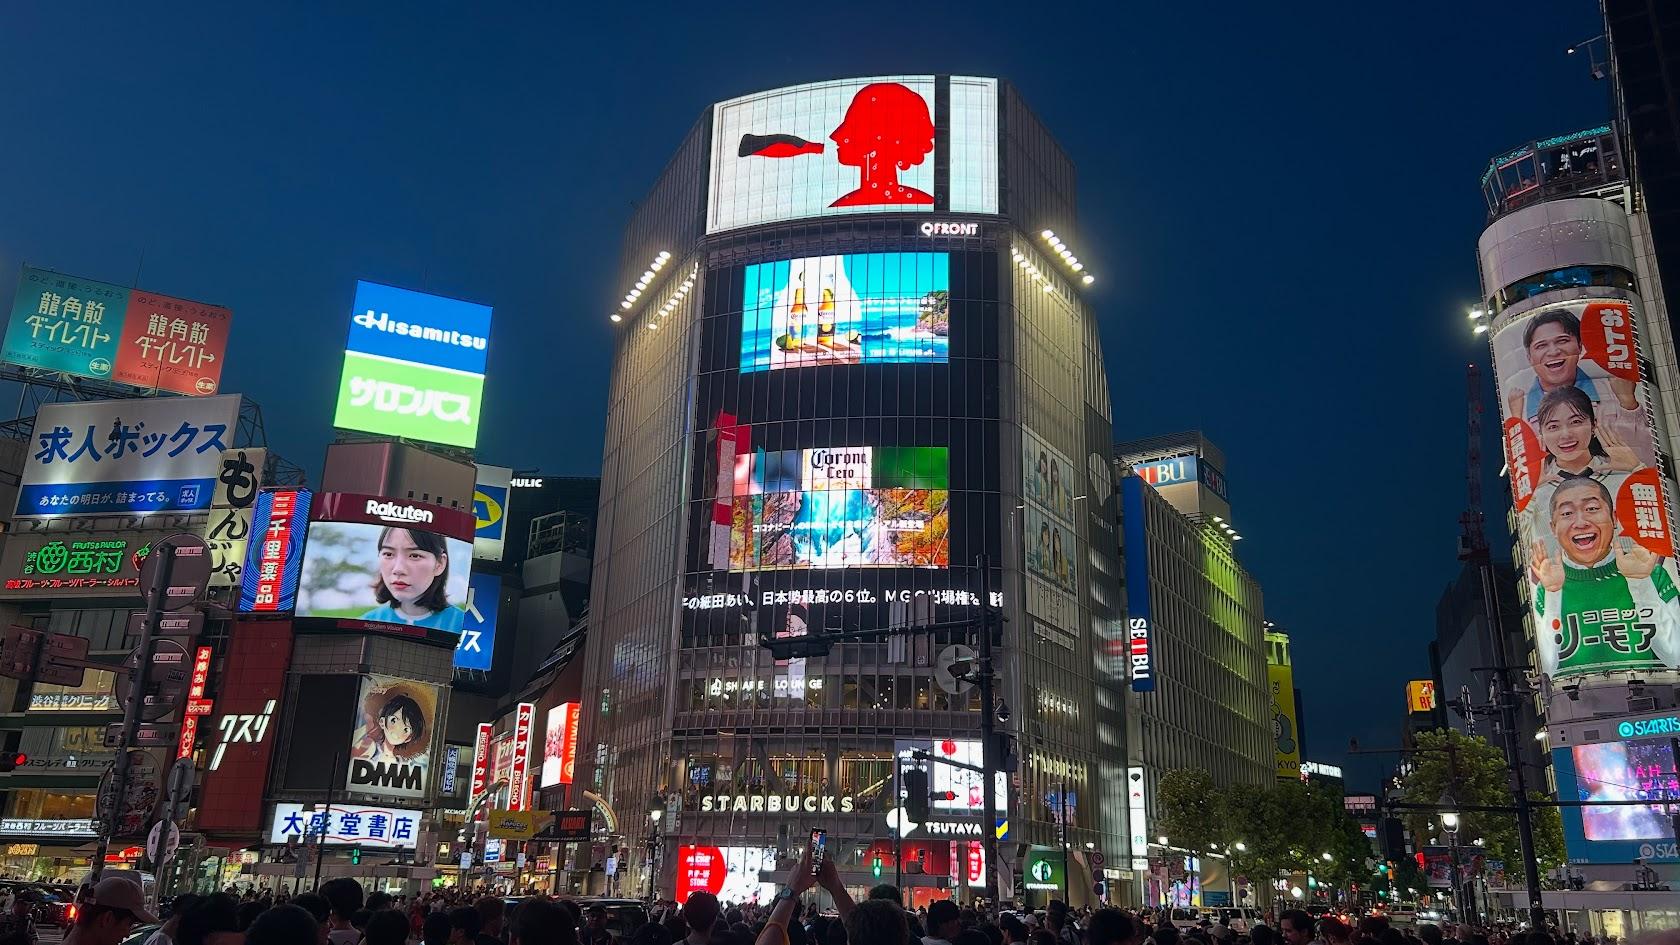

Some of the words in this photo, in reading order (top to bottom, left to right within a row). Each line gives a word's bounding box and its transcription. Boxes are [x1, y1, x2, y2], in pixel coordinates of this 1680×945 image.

[921, 222, 978, 236] QFRONT
[38, 291, 105, 325] 龍角散
[24, 315, 110, 349] ダイレクト
[147, 313, 209, 345] 龍角散
[353, 310, 486, 350] Hisamitsu
[135, 336, 215, 369] ダイレクト
[350, 376, 472, 425] サロンパス
[35, 421, 228, 464] 求人ボックス
[39, 490, 171, 506] あなたの明日が、詰まってる。
[365, 499, 434, 523] Rakuten
[1630, 483, 1662, 530] 無料
[209, 451, 258, 583] もんじゃ
[67, 550, 124, 574] 西村
[255, 496, 291, 604] 三千里薬品
[364, 622, 386, 631] Rakuten
[387, 624, 403, 632] Vision
[1582, 608, 1654, 624] コミック
[1130, 618, 1150, 680] SEIBU
[1552, 613, 1658, 661] シーモア
[726, 680, 764, 691] SHARE
[775, 679, 823, 690] LOUNGE
[515, 711, 530, 764] カラオケ
[1634, 717, 1680, 735] STARTS
[351, 759, 422, 791] DMM
[701, 795, 854, 812] STARBUCKS
[281, 812, 413, 840] 大盛堂書店
[925, 821, 983, 836] TSUTAYA
